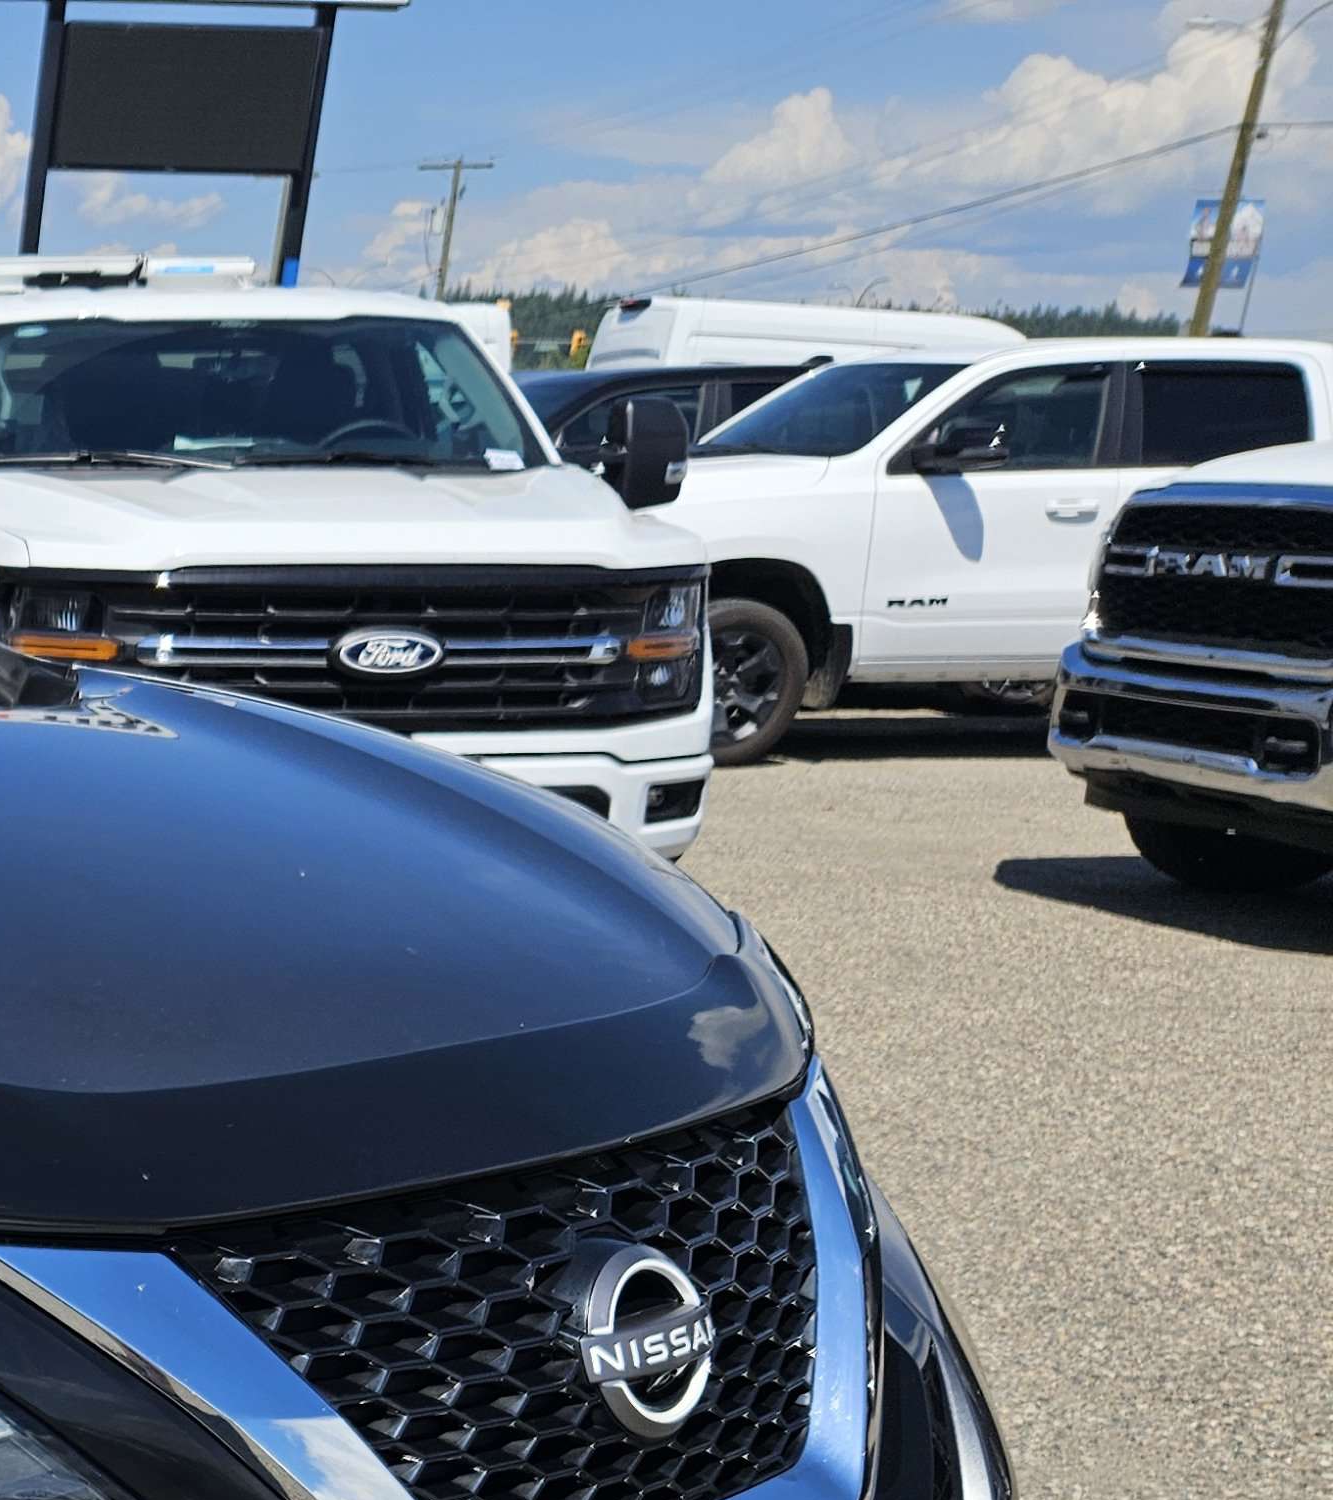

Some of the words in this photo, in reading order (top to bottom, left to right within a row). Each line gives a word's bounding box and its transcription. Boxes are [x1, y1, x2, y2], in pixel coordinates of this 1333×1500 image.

[1155, 551, 1271, 581] RAM
[886, 597, 949, 608] RAM
[358, 639, 423, 667] Ford
